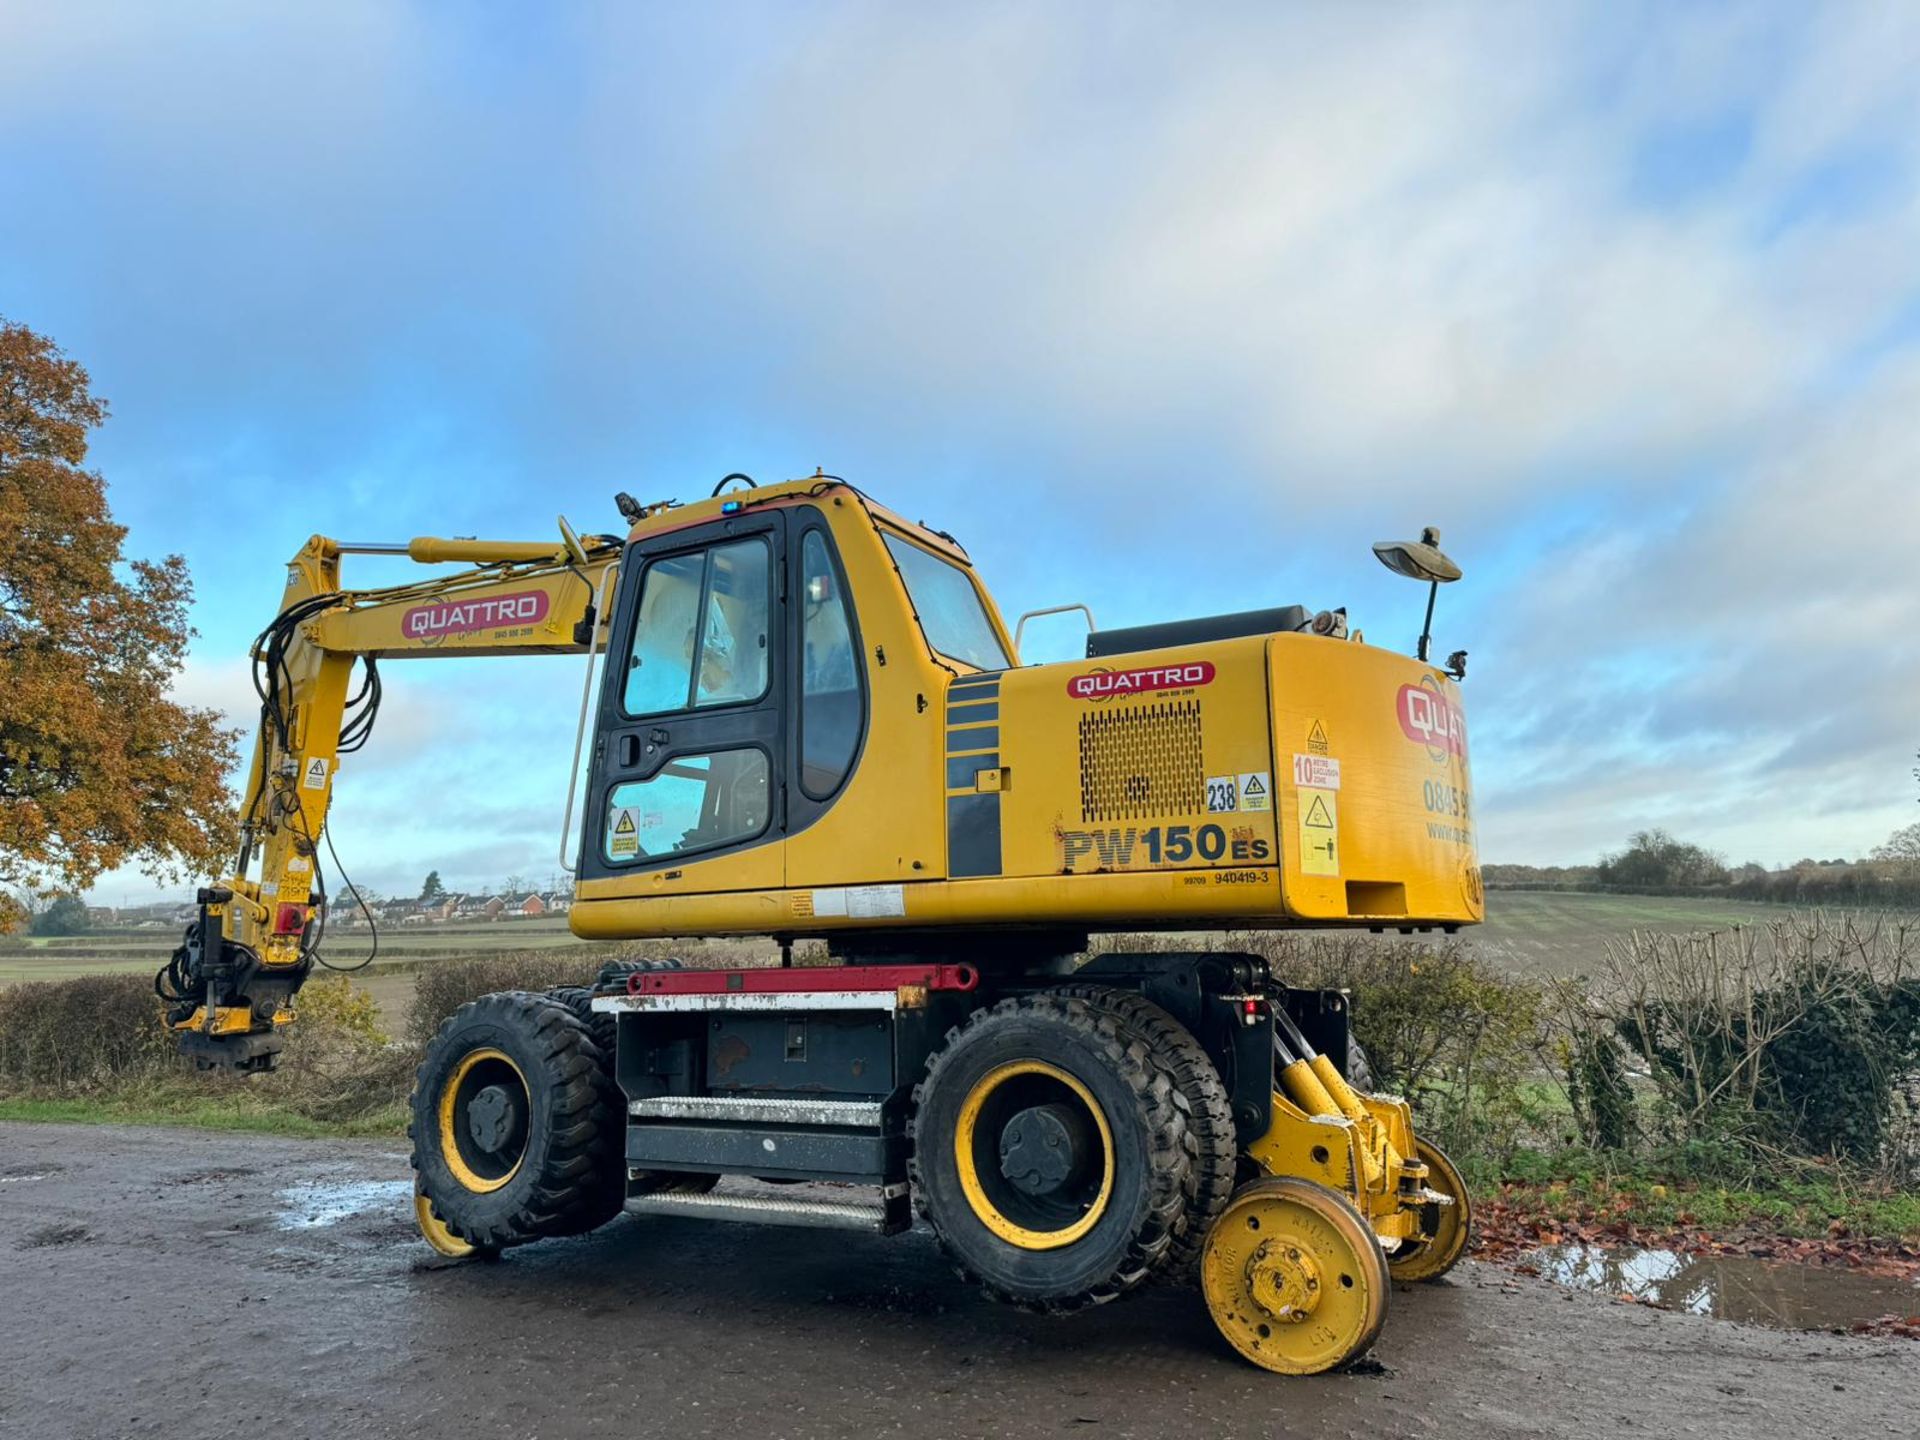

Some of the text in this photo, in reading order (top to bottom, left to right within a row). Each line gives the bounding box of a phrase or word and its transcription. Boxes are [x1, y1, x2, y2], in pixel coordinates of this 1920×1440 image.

[411, 597, 537, 634] QUATTRO
[1077, 666, 1203, 694] QUATTRO
[1295, 756, 1313, 784] 10
[1208, 783, 1235, 811] 238
[1423, 780, 1459, 817] 0845
[1231, 840, 1269, 860] ES
[1215, 871, 1269, 884] 940419-3
